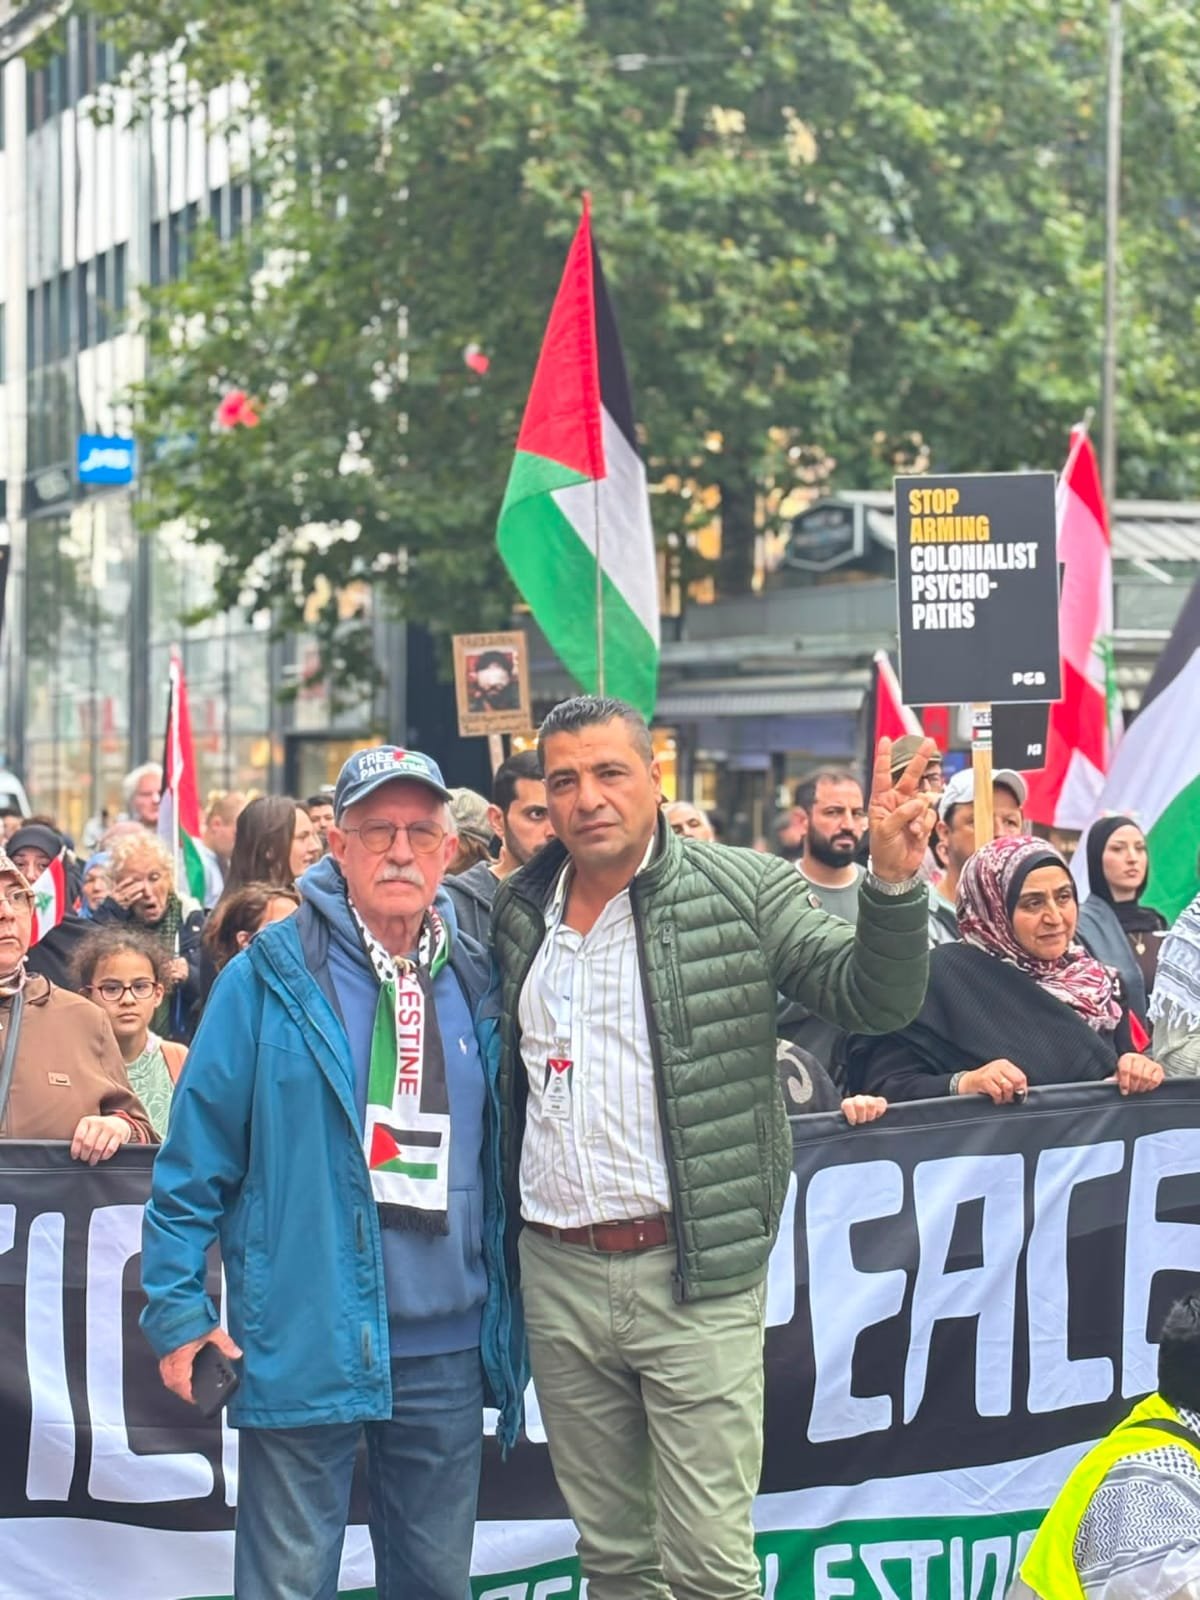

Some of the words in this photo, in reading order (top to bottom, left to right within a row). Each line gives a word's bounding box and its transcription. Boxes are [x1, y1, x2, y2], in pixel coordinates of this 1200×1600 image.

[909, 488, 959, 515] STOP
[910, 515, 990, 543] ARMING
[910, 542, 1038, 572] COLONIALIST
[911, 572, 998, 601] PSYCHO-
[912, 602, 975, 630] PATHS
[359, 751, 395, 770] FREE
[764, 1128, 1200, 1444] EACE
